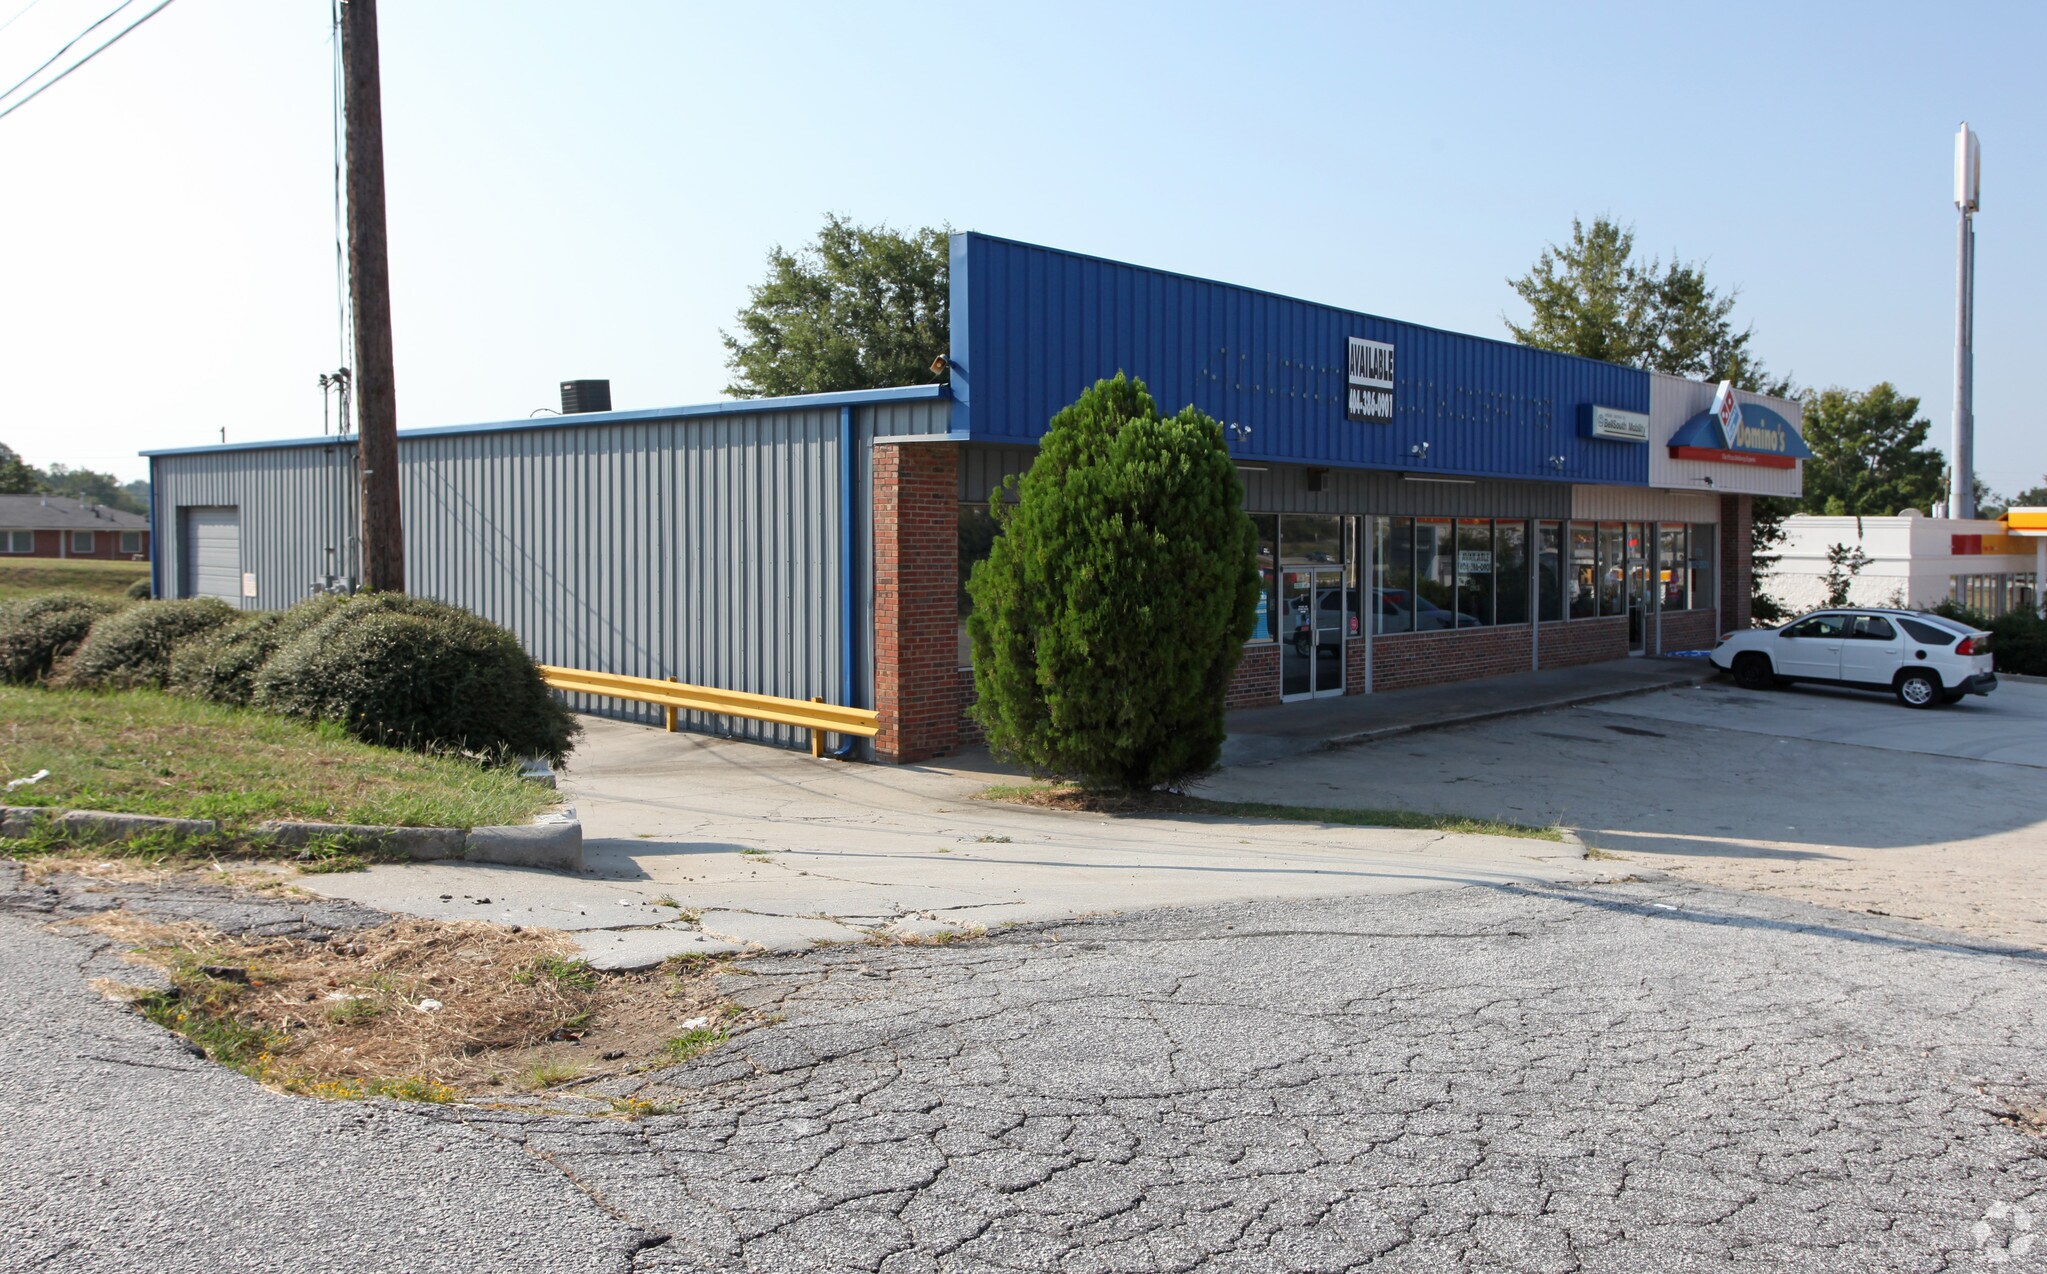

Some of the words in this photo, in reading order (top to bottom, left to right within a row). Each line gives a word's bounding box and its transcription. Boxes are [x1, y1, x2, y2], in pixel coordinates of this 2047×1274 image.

[1349, 343, 1393, 382] AVAILABLE
[1348, 388, 1393, 418] 404-386-0901
[1604, 418, 1627, 430] BellSouth
[1736, 420, 1785, 452] Domino's
